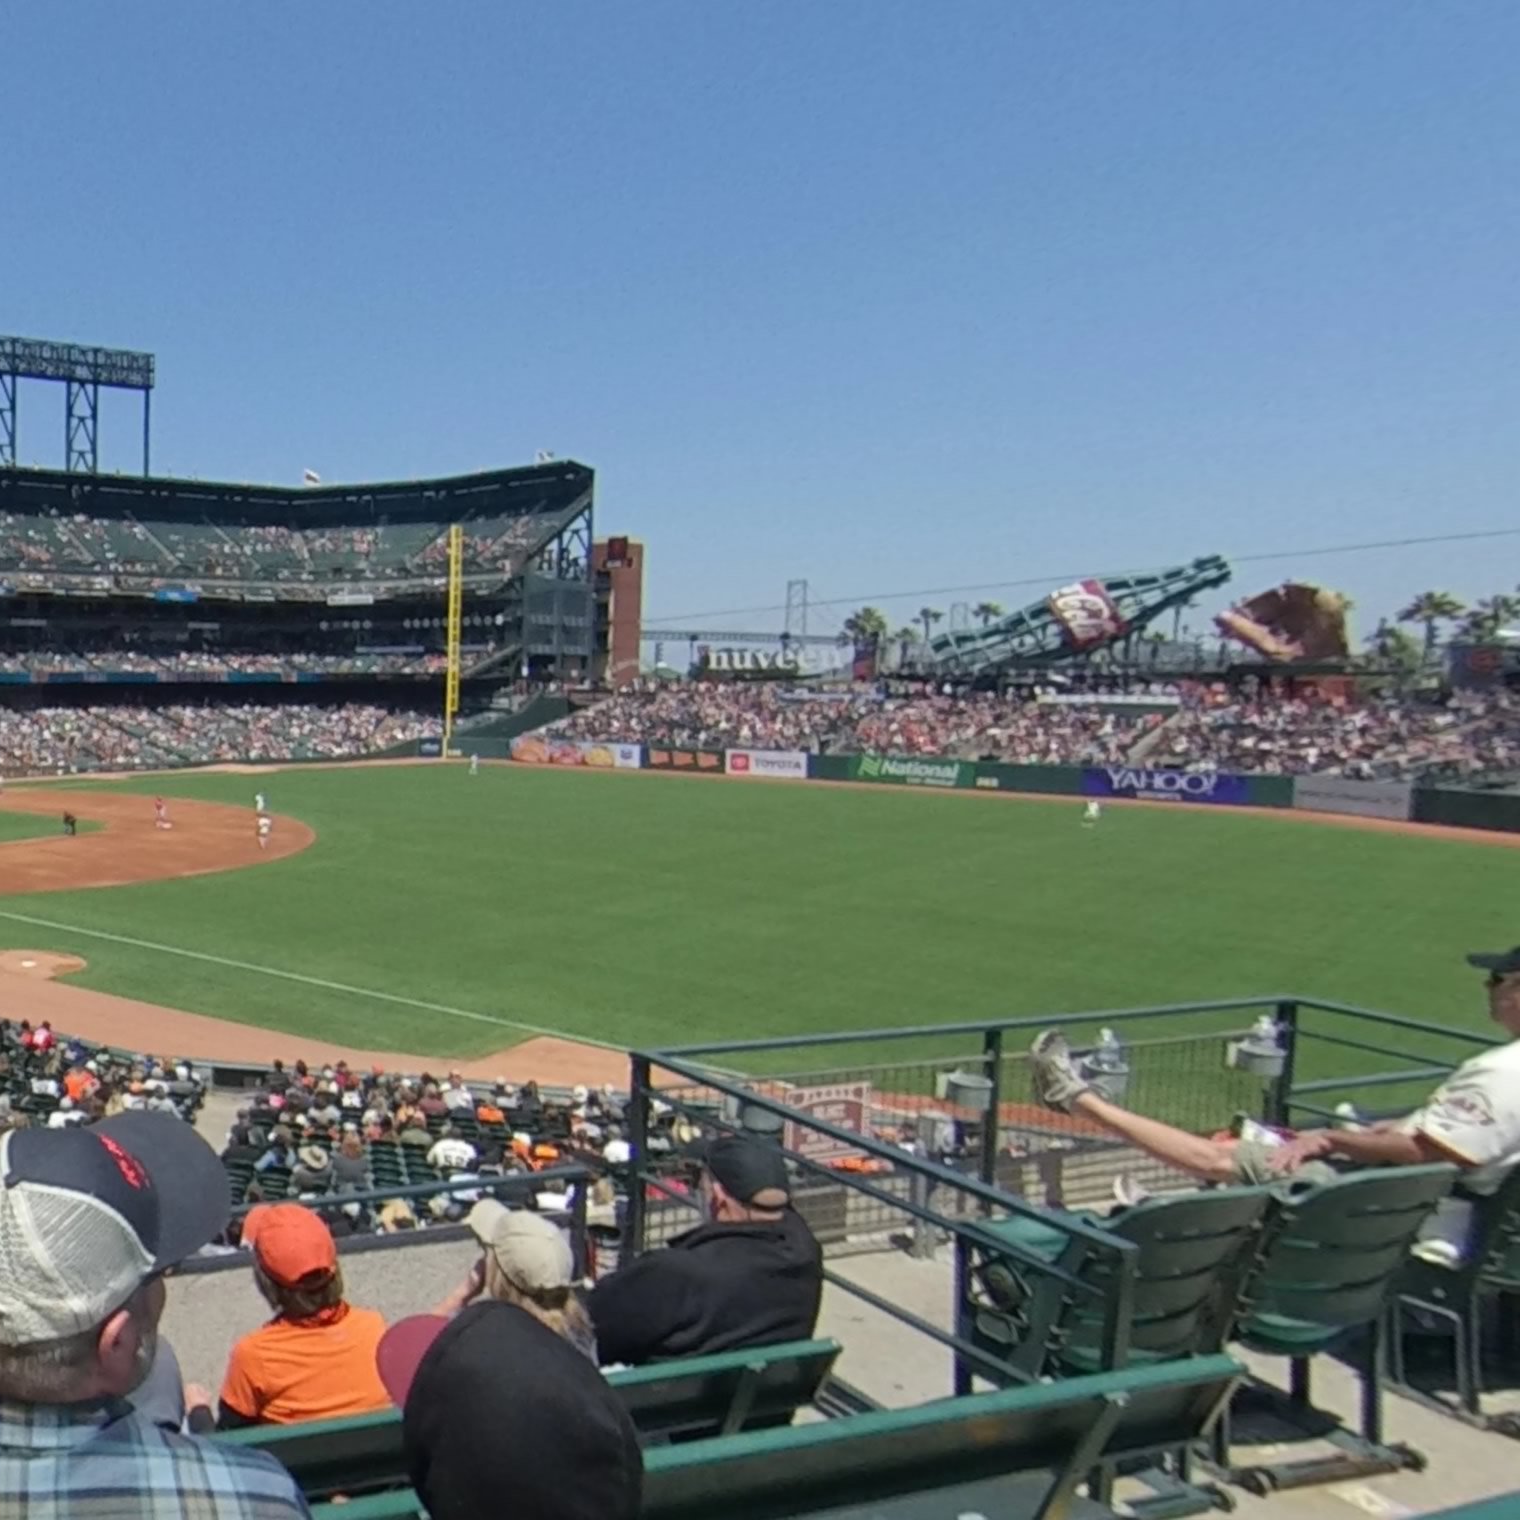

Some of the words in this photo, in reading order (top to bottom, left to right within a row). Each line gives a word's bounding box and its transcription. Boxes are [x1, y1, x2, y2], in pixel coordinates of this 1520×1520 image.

[709, 648, 842, 670] nuveen
[754, 758, 802, 770] TOYOTA
[881, 760, 960, 779] National
[1106, 768, 1218, 796] YAHOO!
